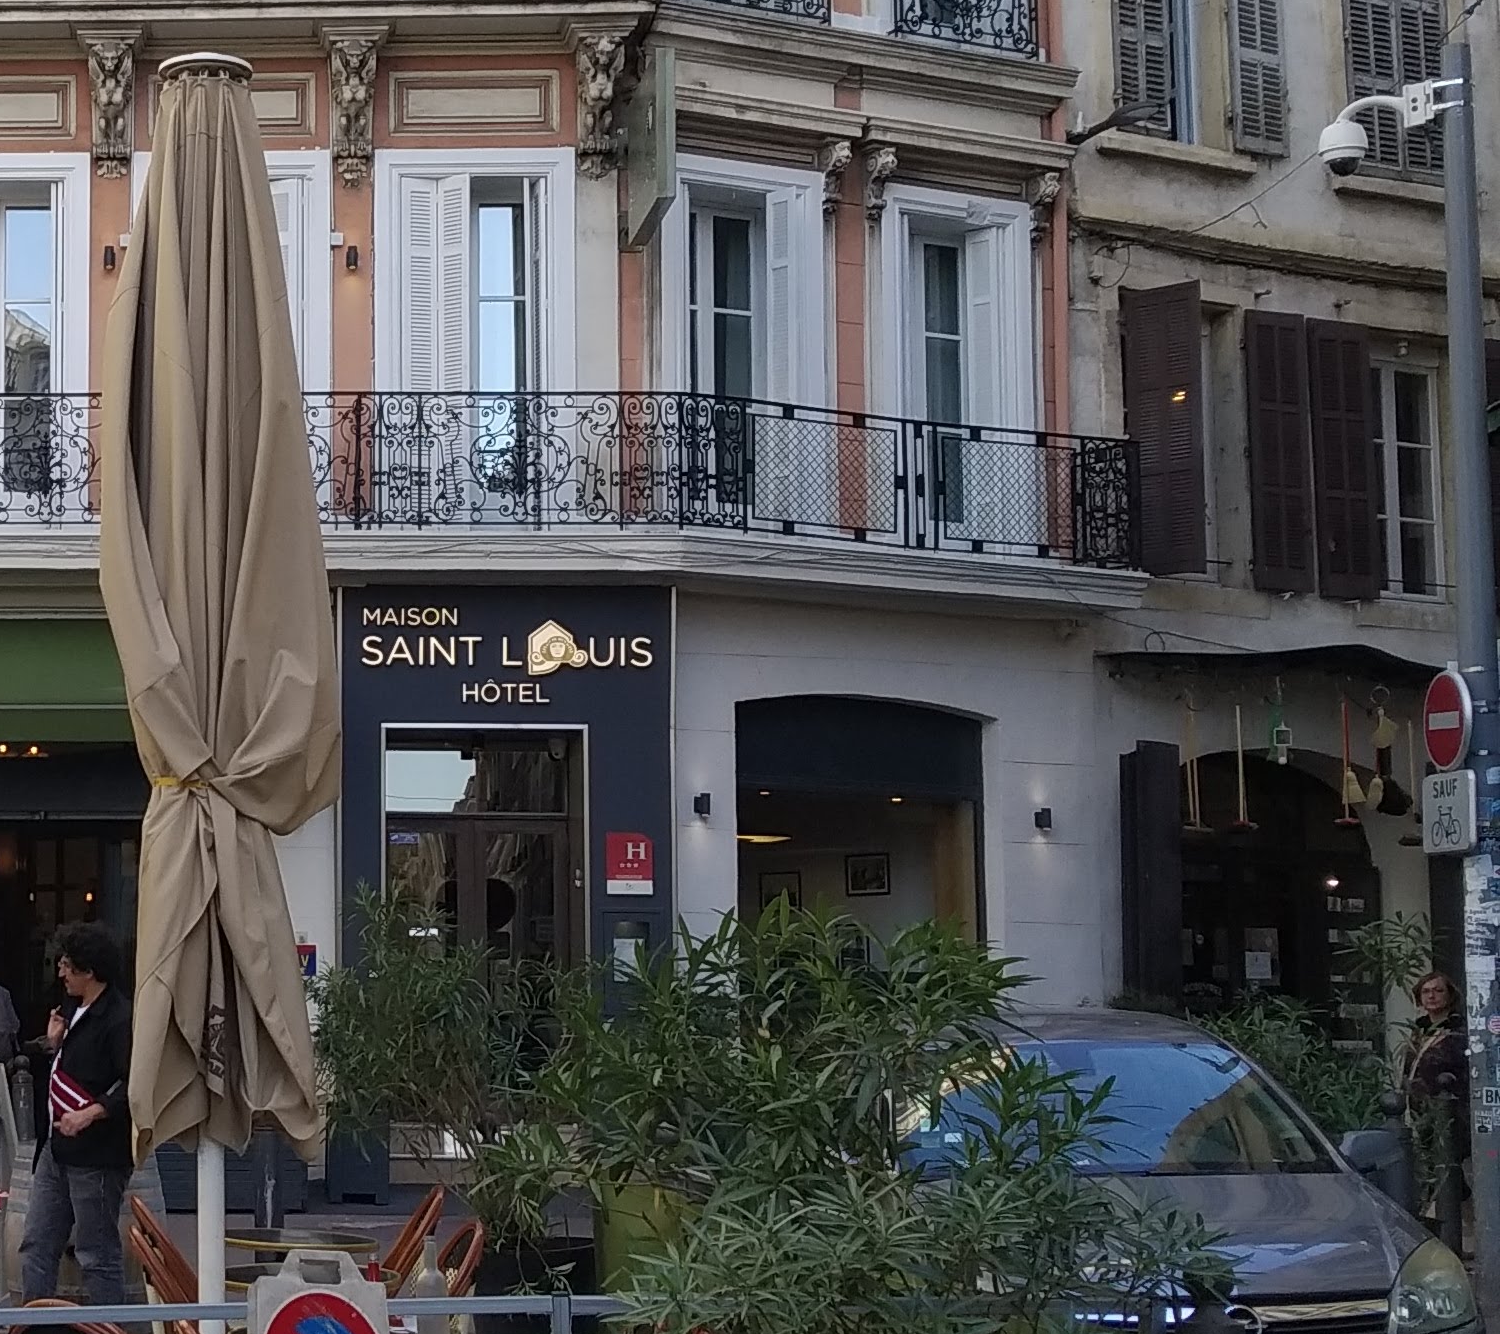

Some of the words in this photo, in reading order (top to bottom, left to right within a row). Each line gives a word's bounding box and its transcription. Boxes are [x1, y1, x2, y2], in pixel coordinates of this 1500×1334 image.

[362, 607, 458, 626] MAISON
[360, 635, 483, 667] SAINT
[461, 678, 551, 703] HÔTEL
[1432, 778, 1459, 799] SAUF
[626, 842, 647, 860] H
